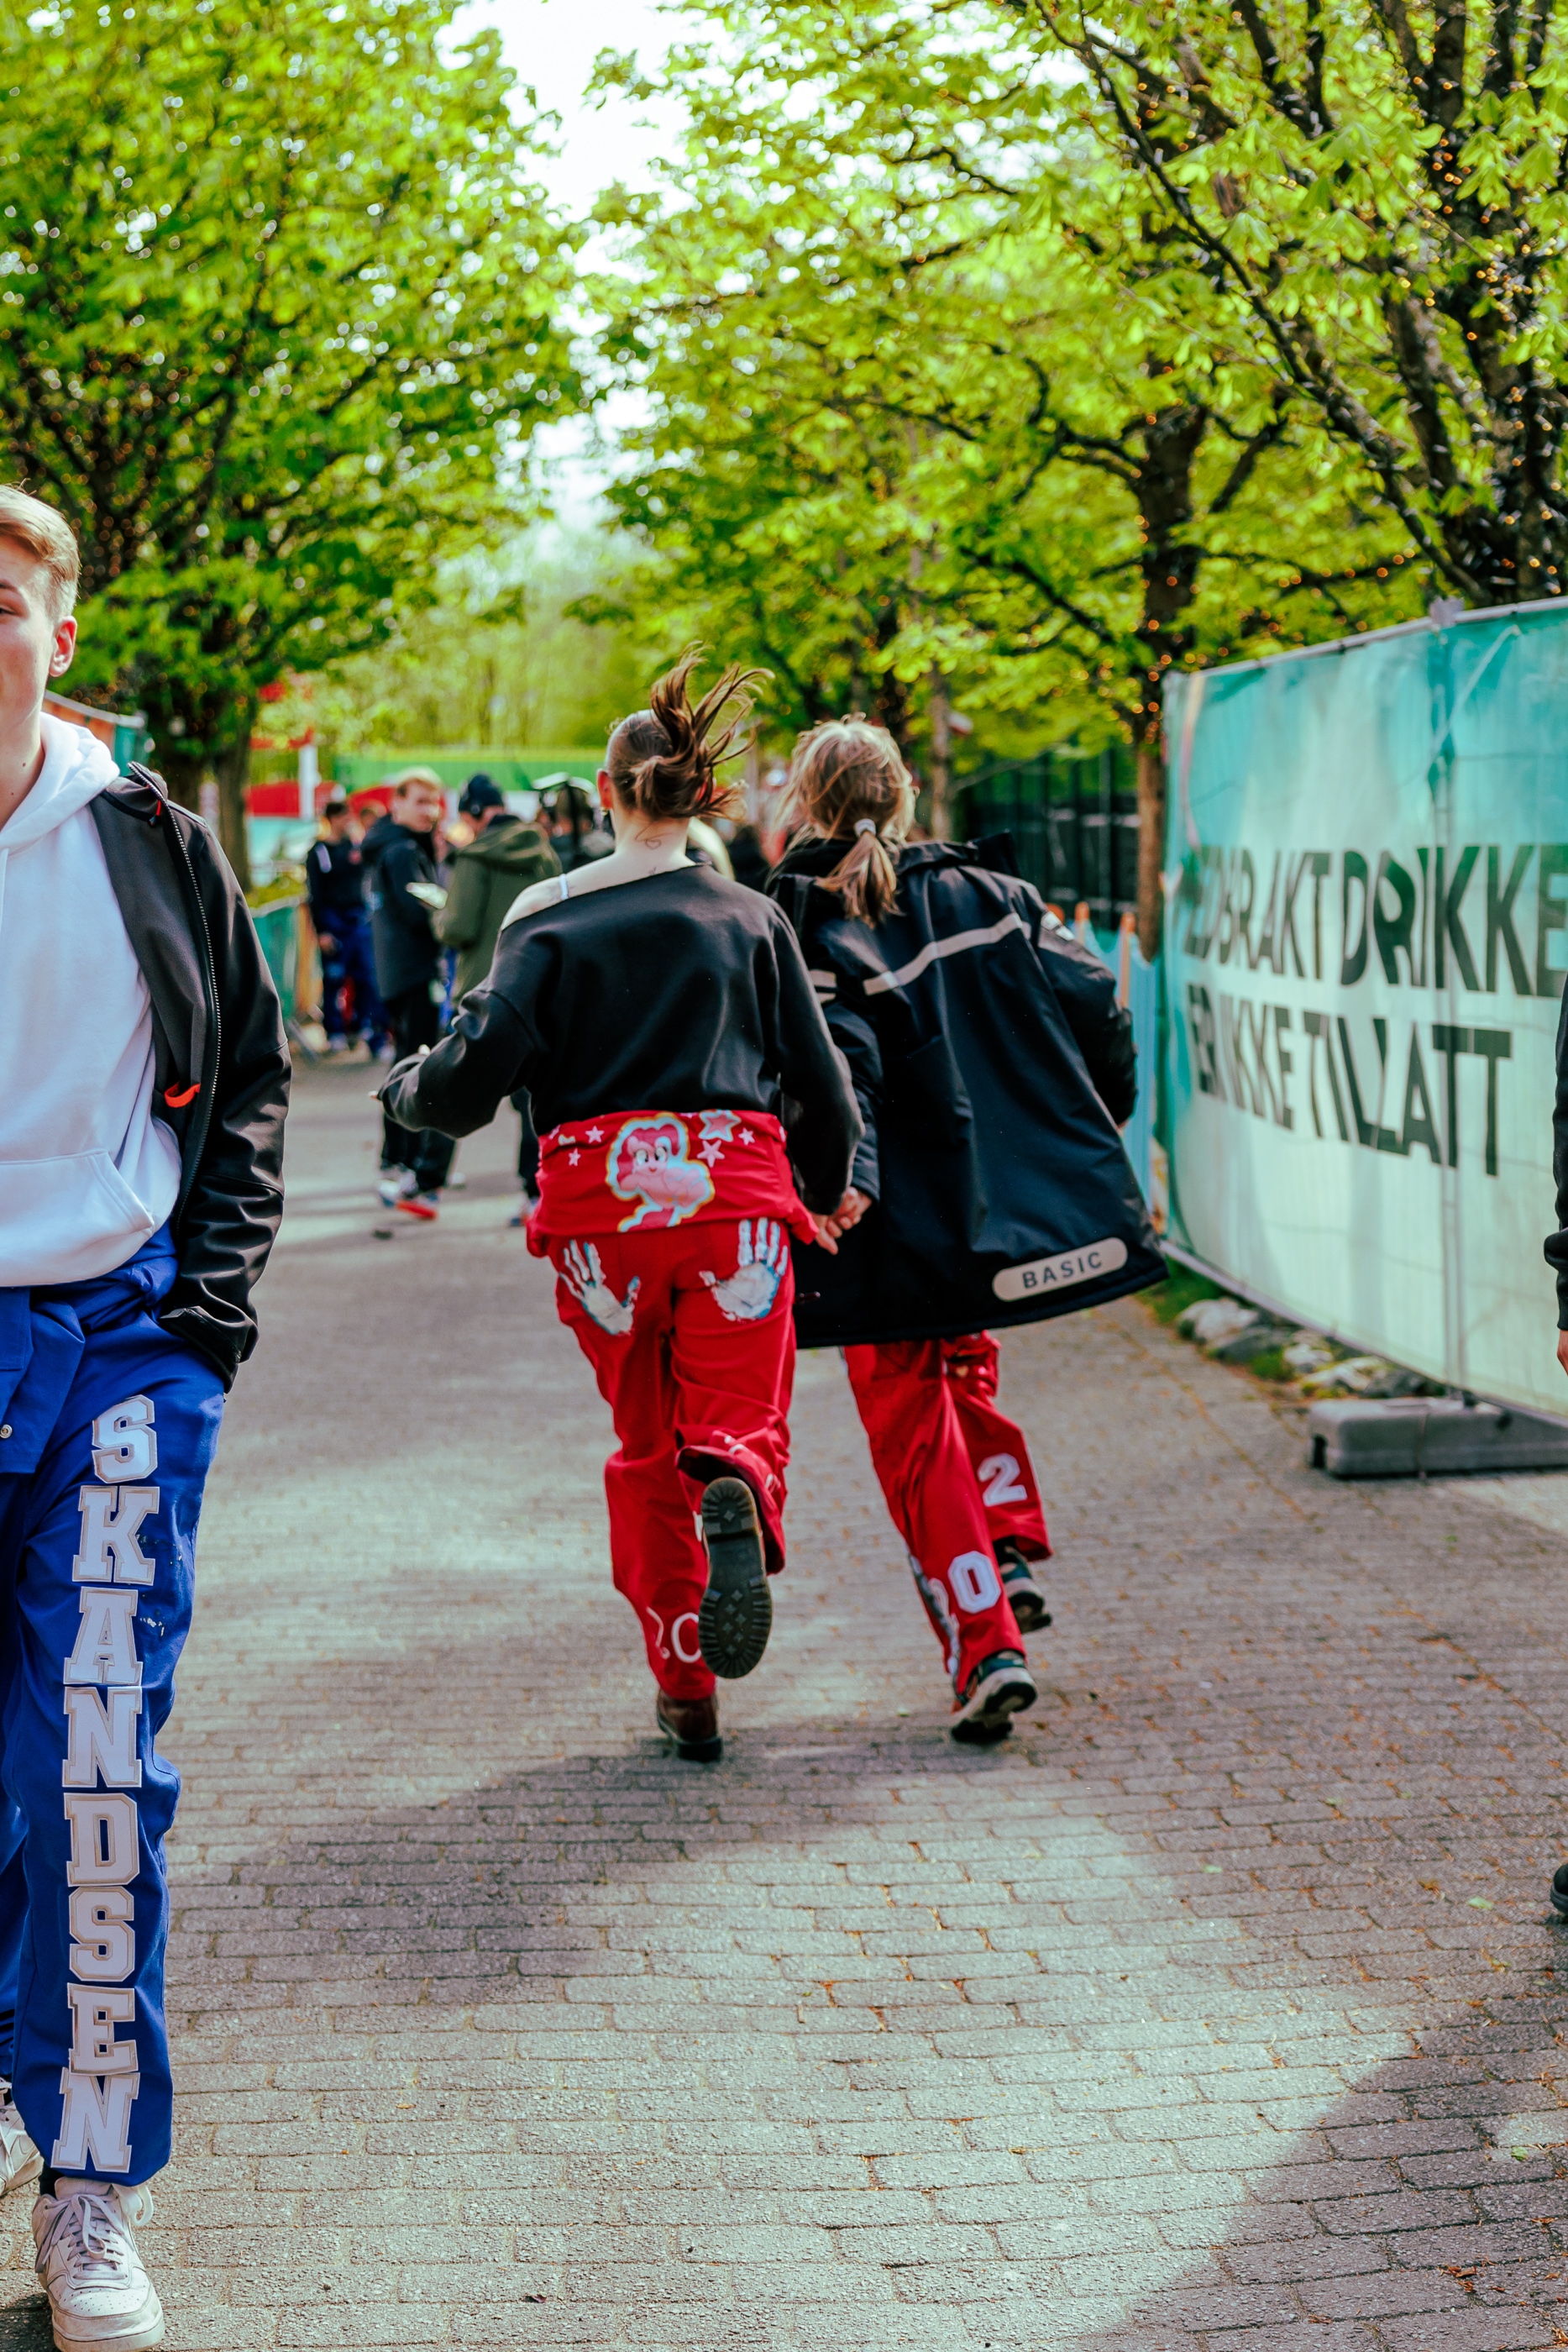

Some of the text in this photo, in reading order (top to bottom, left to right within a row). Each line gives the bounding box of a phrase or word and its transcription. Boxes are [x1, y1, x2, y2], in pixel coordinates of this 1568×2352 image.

[1340, 844, 1568, 998] DRIKKE
[1021, 1252, 1102, 1289] BASIC
[977, 1452, 1028, 1507] 2
[51, 1394, 160, 2174] SKANDSEN
